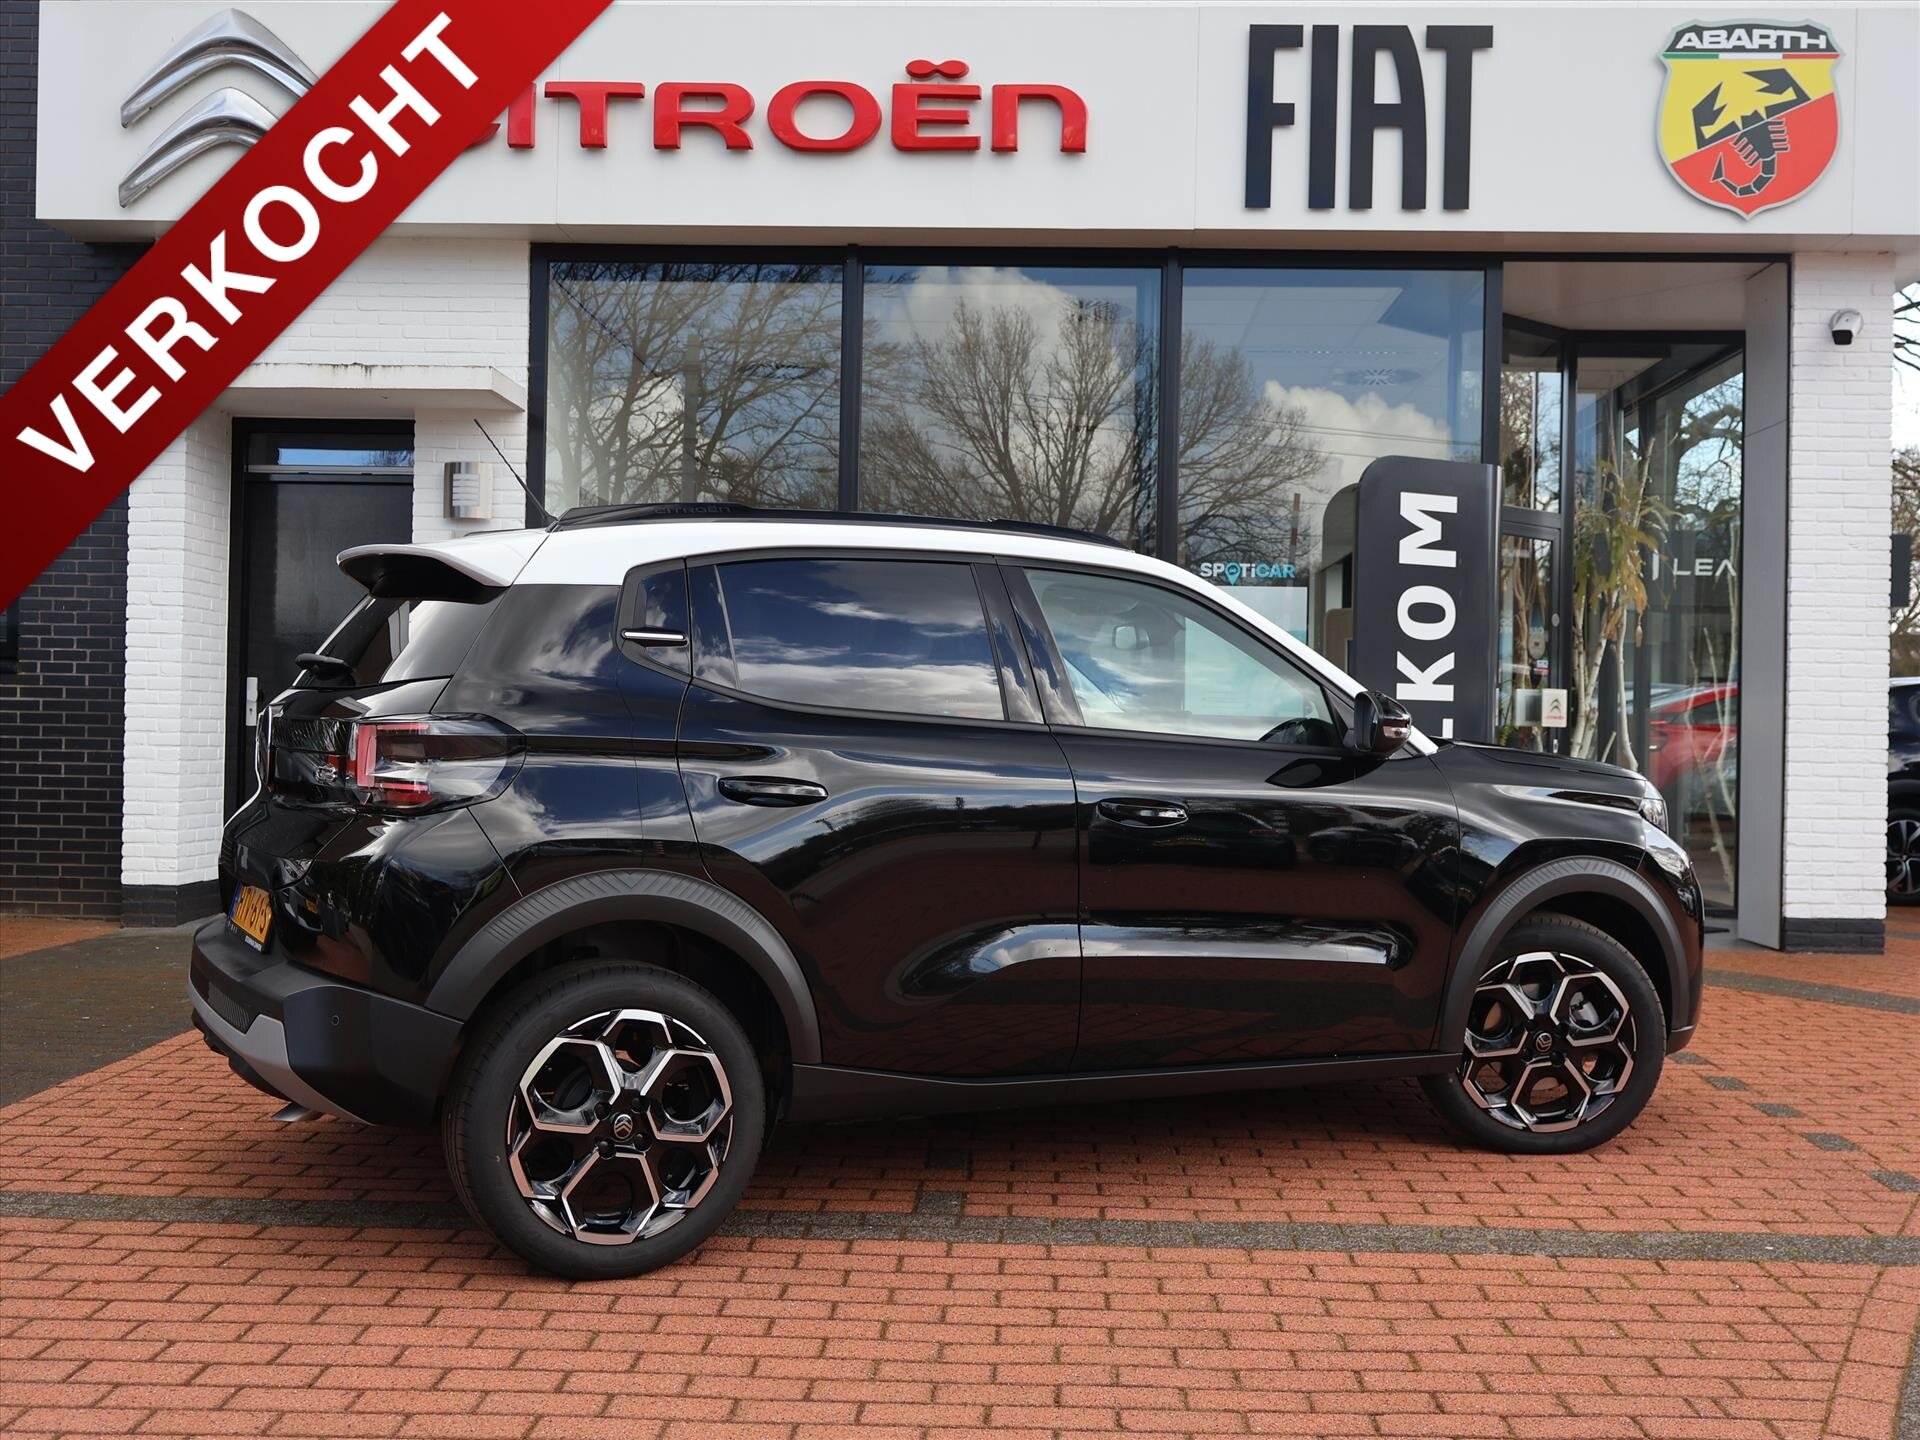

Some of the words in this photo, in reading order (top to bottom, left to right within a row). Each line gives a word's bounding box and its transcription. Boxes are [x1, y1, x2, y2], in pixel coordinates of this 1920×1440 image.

[466, 59, 1089, 152] ITROËN
[1675, 28, 1828, 49] ABARTH
[1245, 24, 1494, 210] FIAT
[1396, 491, 1458, 739] KOM
